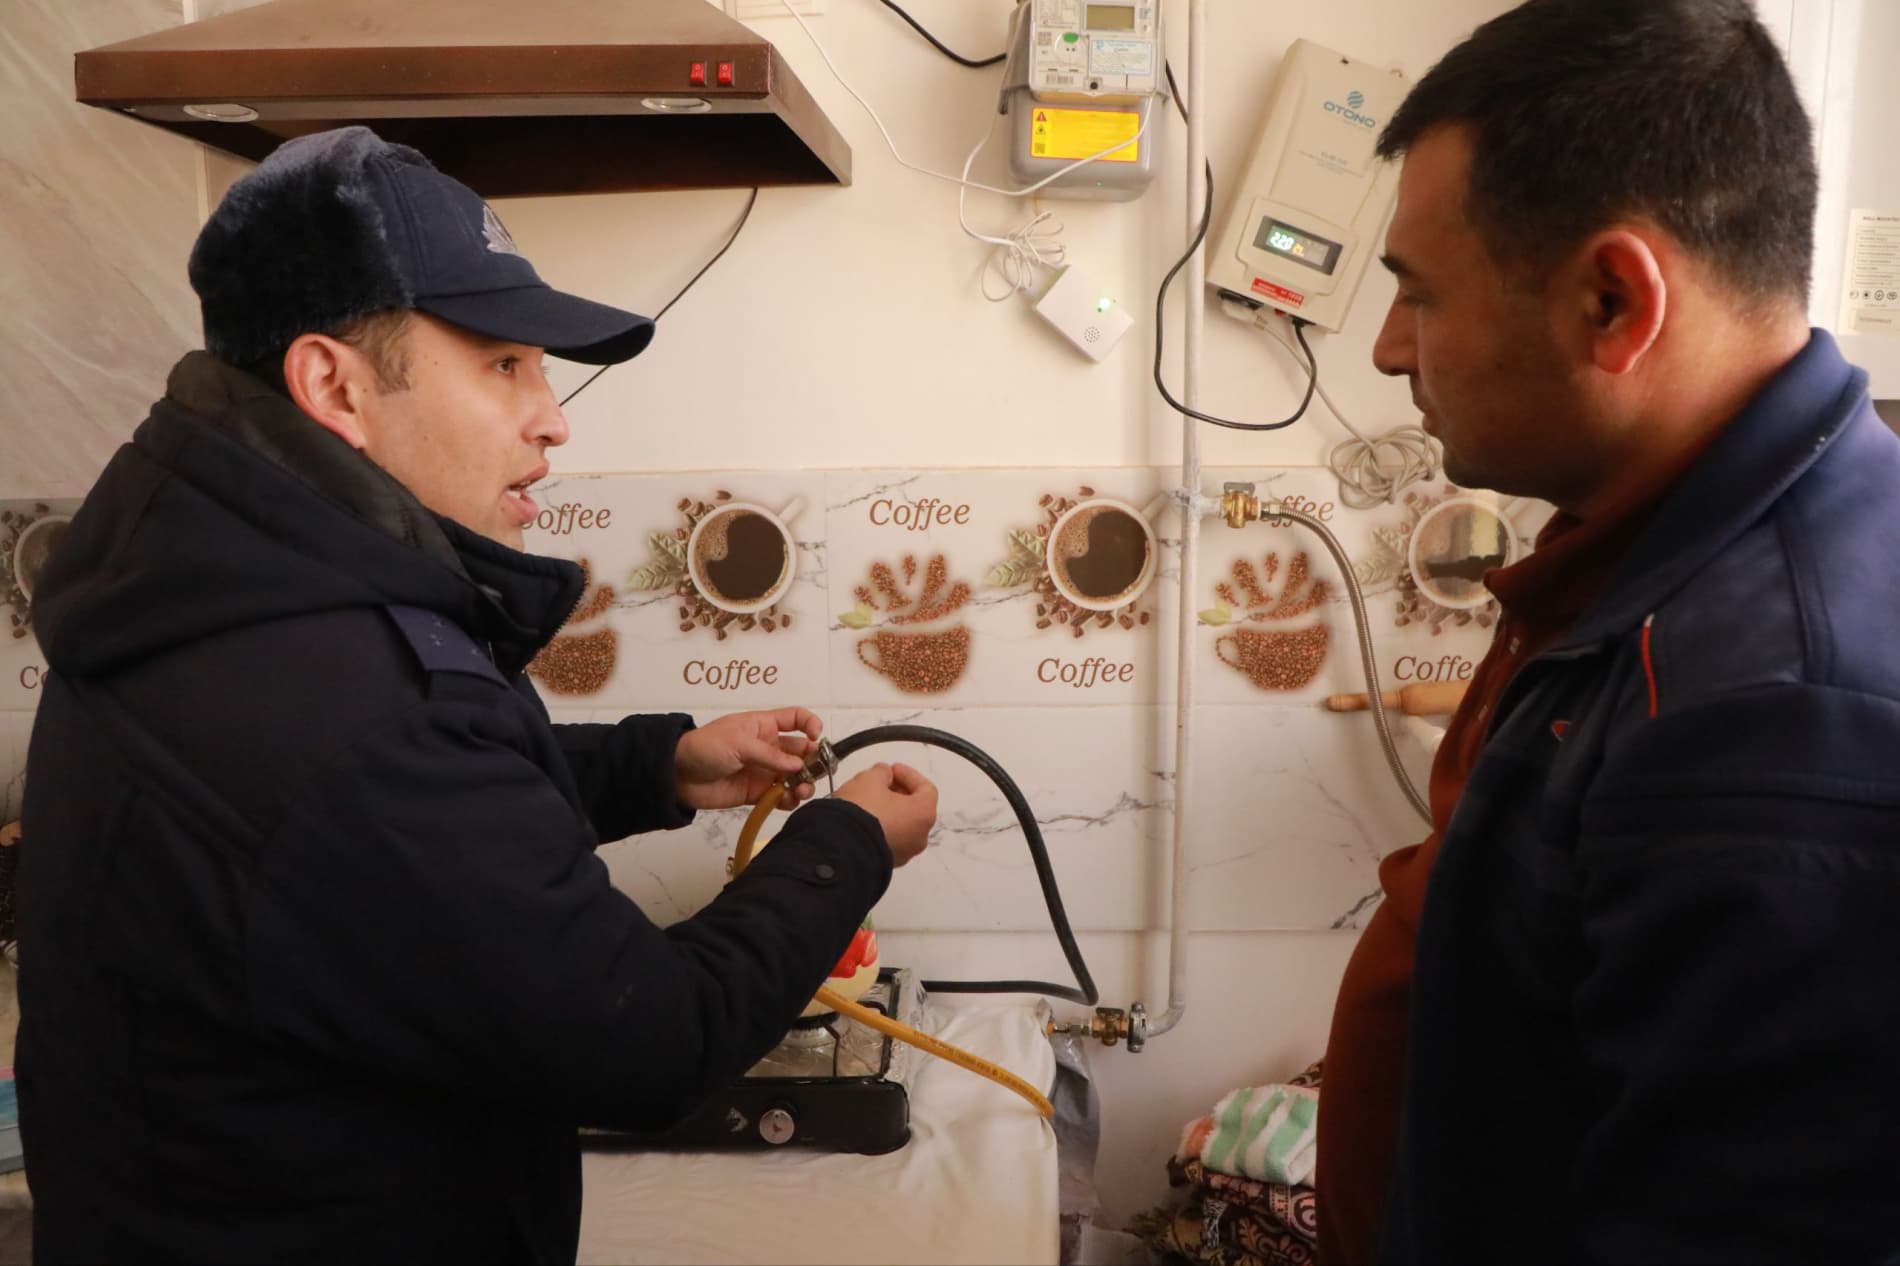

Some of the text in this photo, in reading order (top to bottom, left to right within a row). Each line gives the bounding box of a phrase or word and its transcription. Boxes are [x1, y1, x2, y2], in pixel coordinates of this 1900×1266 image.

[1323, 101, 1376, 129] OTONO
[521, 503, 612, 535] offee
[868, 498, 971, 531] Coffee
[682, 659, 779, 691] Coffee
[1036, 657, 1135, 689] Coffee
[1393, 655, 1476, 683] Coffe
